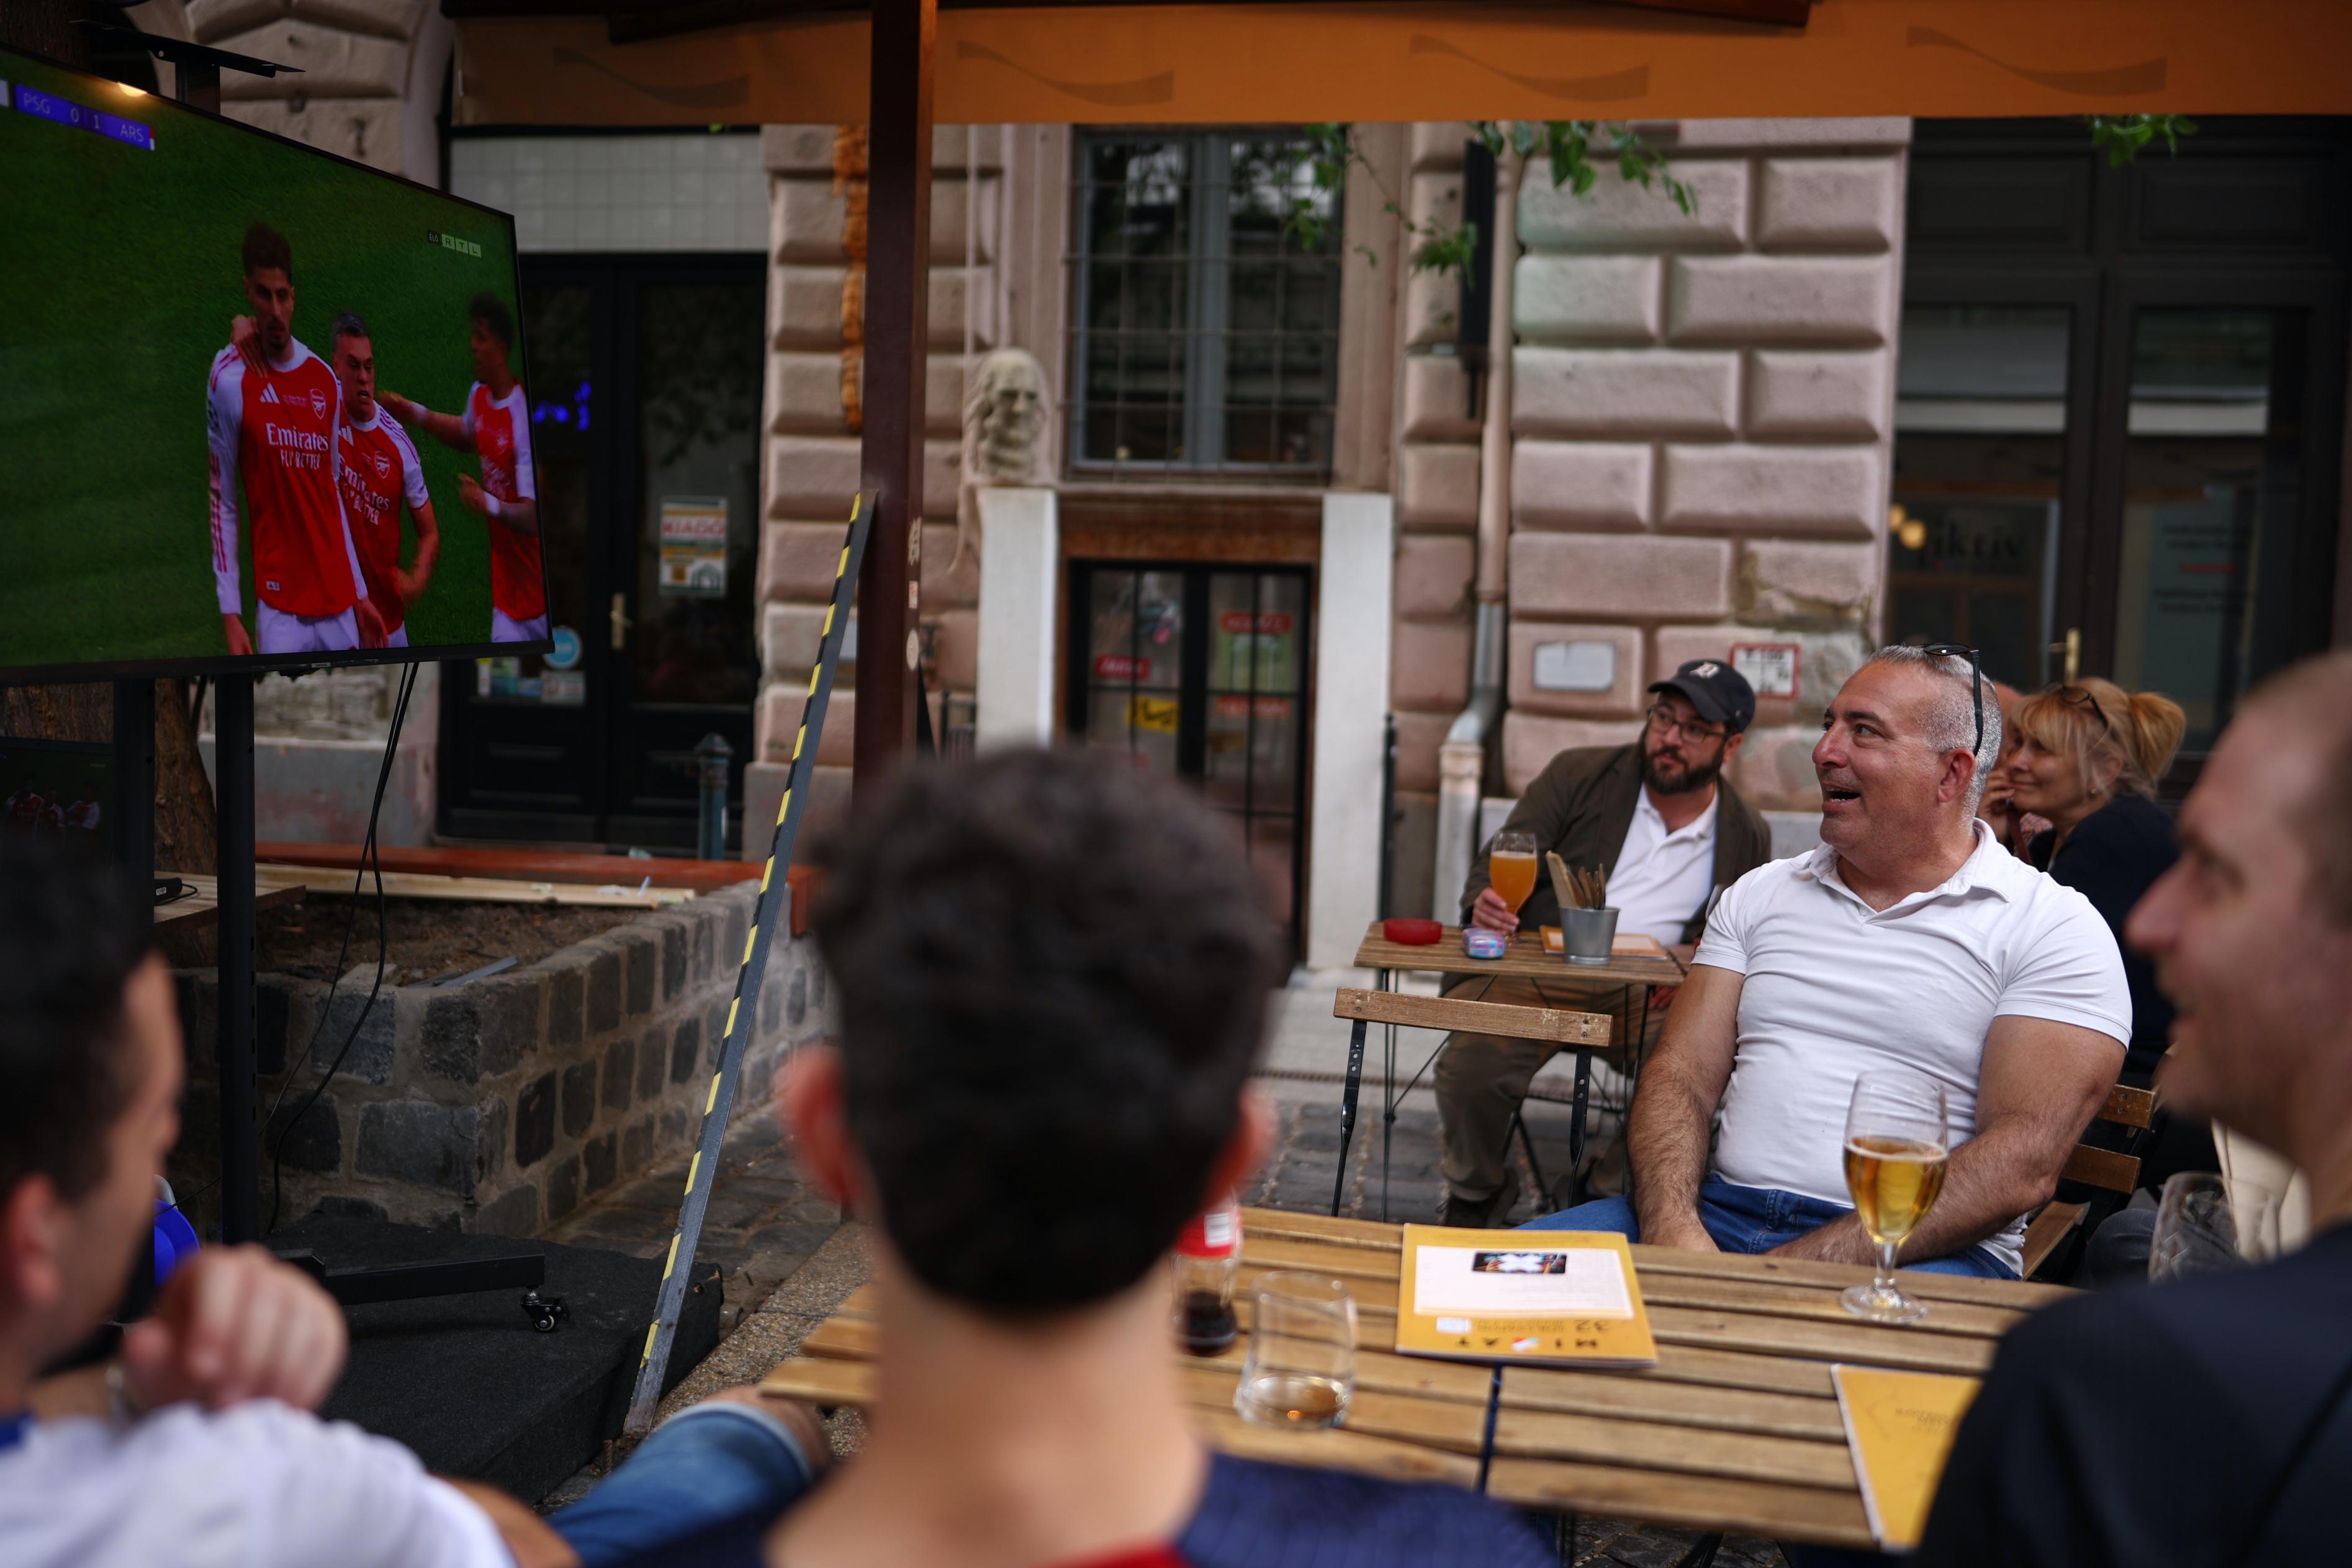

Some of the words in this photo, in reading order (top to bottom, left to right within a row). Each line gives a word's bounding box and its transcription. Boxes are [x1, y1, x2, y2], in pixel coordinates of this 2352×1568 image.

[24, 92, 50, 114] PSG
[71, 107, 79, 123] 0
[94, 114, 100, 130] 1
[120, 124, 144, 143] ARS
[443, 236, 479, 255] RTL
[265, 422, 329, 451] Emirates
[281, 449, 294, 467] FLY
[295, 451, 321, 471] BETTER
